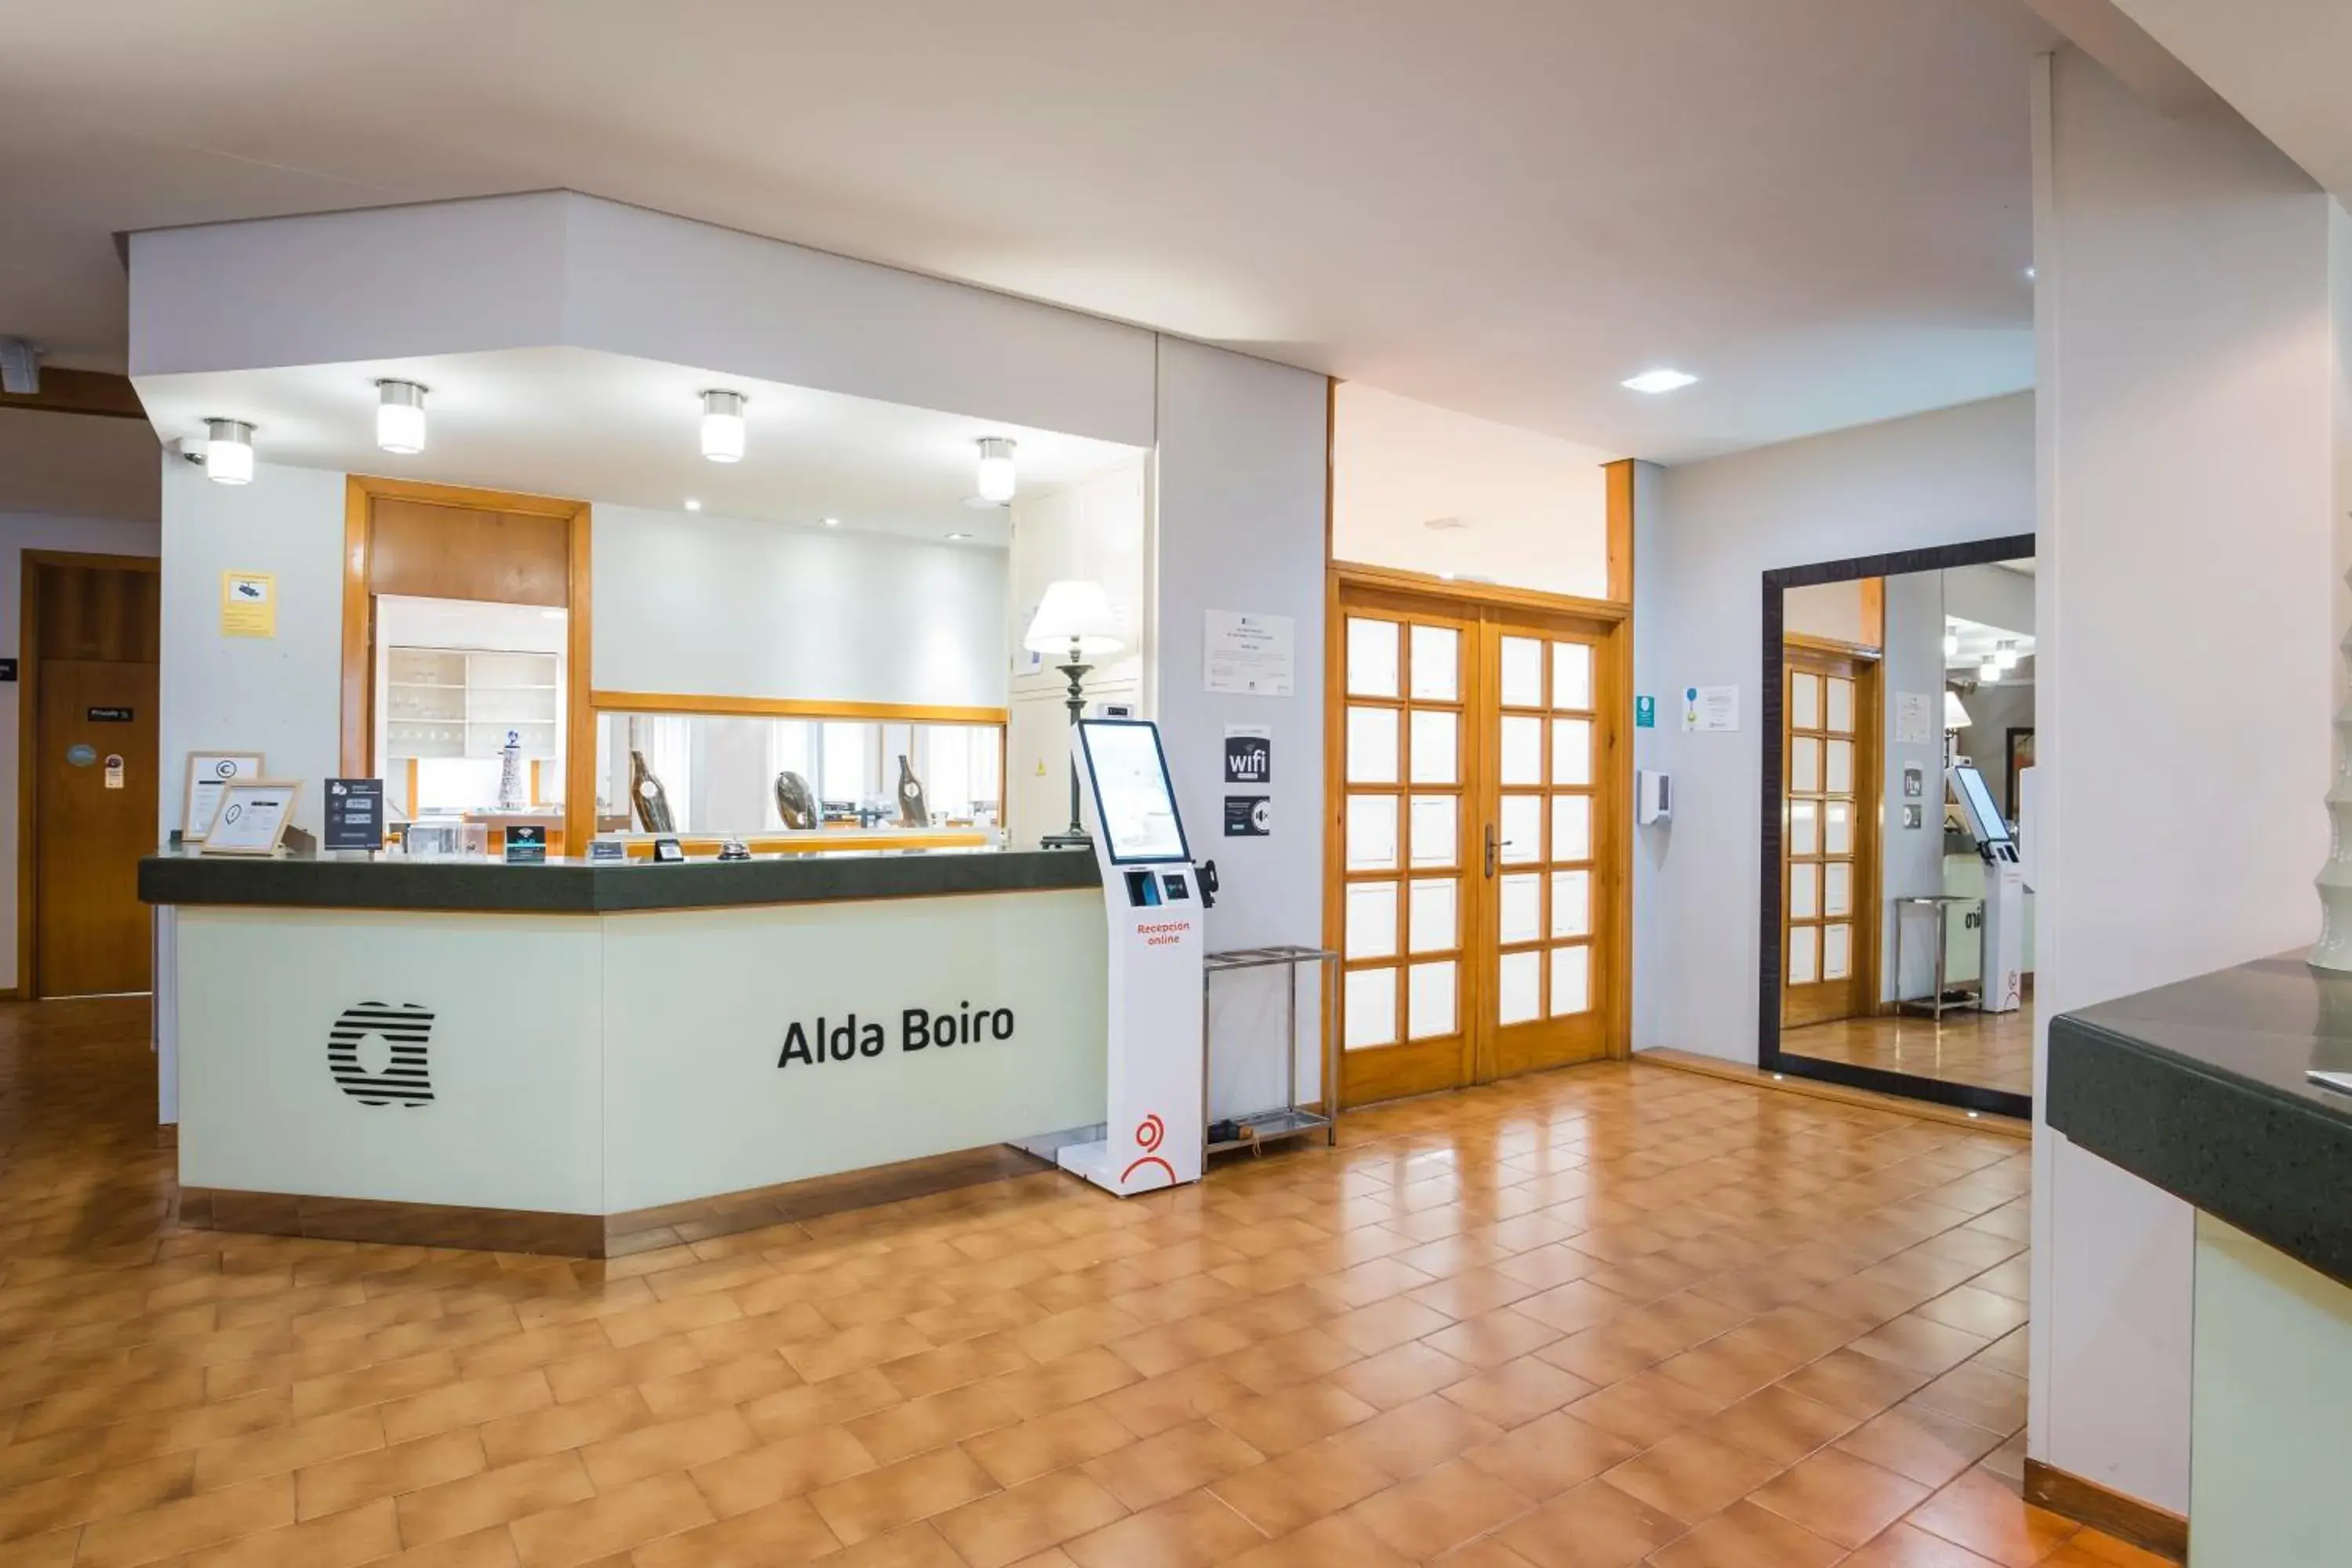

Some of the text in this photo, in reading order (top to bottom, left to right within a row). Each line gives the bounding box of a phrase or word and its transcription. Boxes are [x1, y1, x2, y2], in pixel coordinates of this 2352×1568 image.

[1229, 749, 1265, 772] wifi
[1147, 934, 1180, 945] online
[777, 1000, 1014, 1069] Alda Boiro
